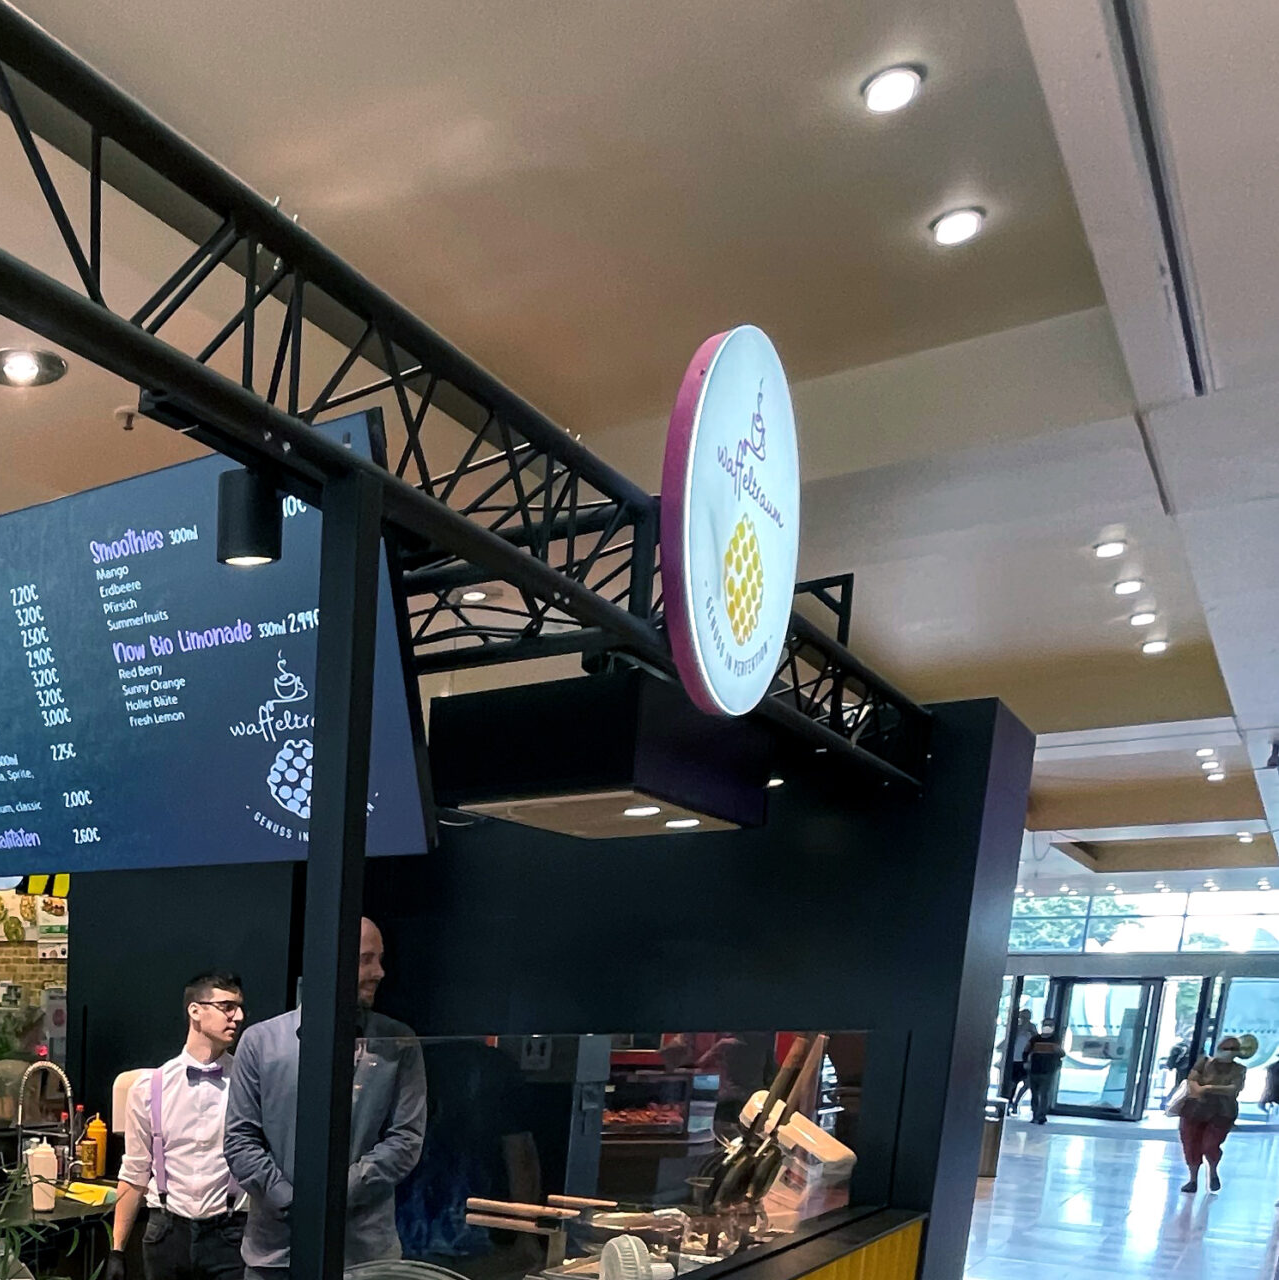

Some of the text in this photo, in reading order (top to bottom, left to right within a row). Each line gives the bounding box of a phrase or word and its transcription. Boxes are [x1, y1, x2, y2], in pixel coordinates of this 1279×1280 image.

[717, 438, 784, 528] waffeltraum
[89, 528, 164, 565] Smoothies
[96, 565, 130, 581] Mango
[99, 579, 142, 599] Erdbeere
[103, 599, 138, 615] Pfirsich
[107, 610, 169, 632] Summerfruits
[150, 633, 174, 658] Bio
[177, 617, 253, 653] Limonade
[257, 619, 287, 639] 330ml
[119, 664, 163, 681] Red Berry
[122, 677, 186, 698] Sunny Orange
[41, 707, 72, 728] 3,00€
[130, 711, 186, 728] Fresh Lemon
[229, 699, 316, 742] waffeltr
[62, 789, 93, 809] 2,00€
[72, 826, 102, 845] 2,60€
[254, 810, 310, 842] GENUSS IN
